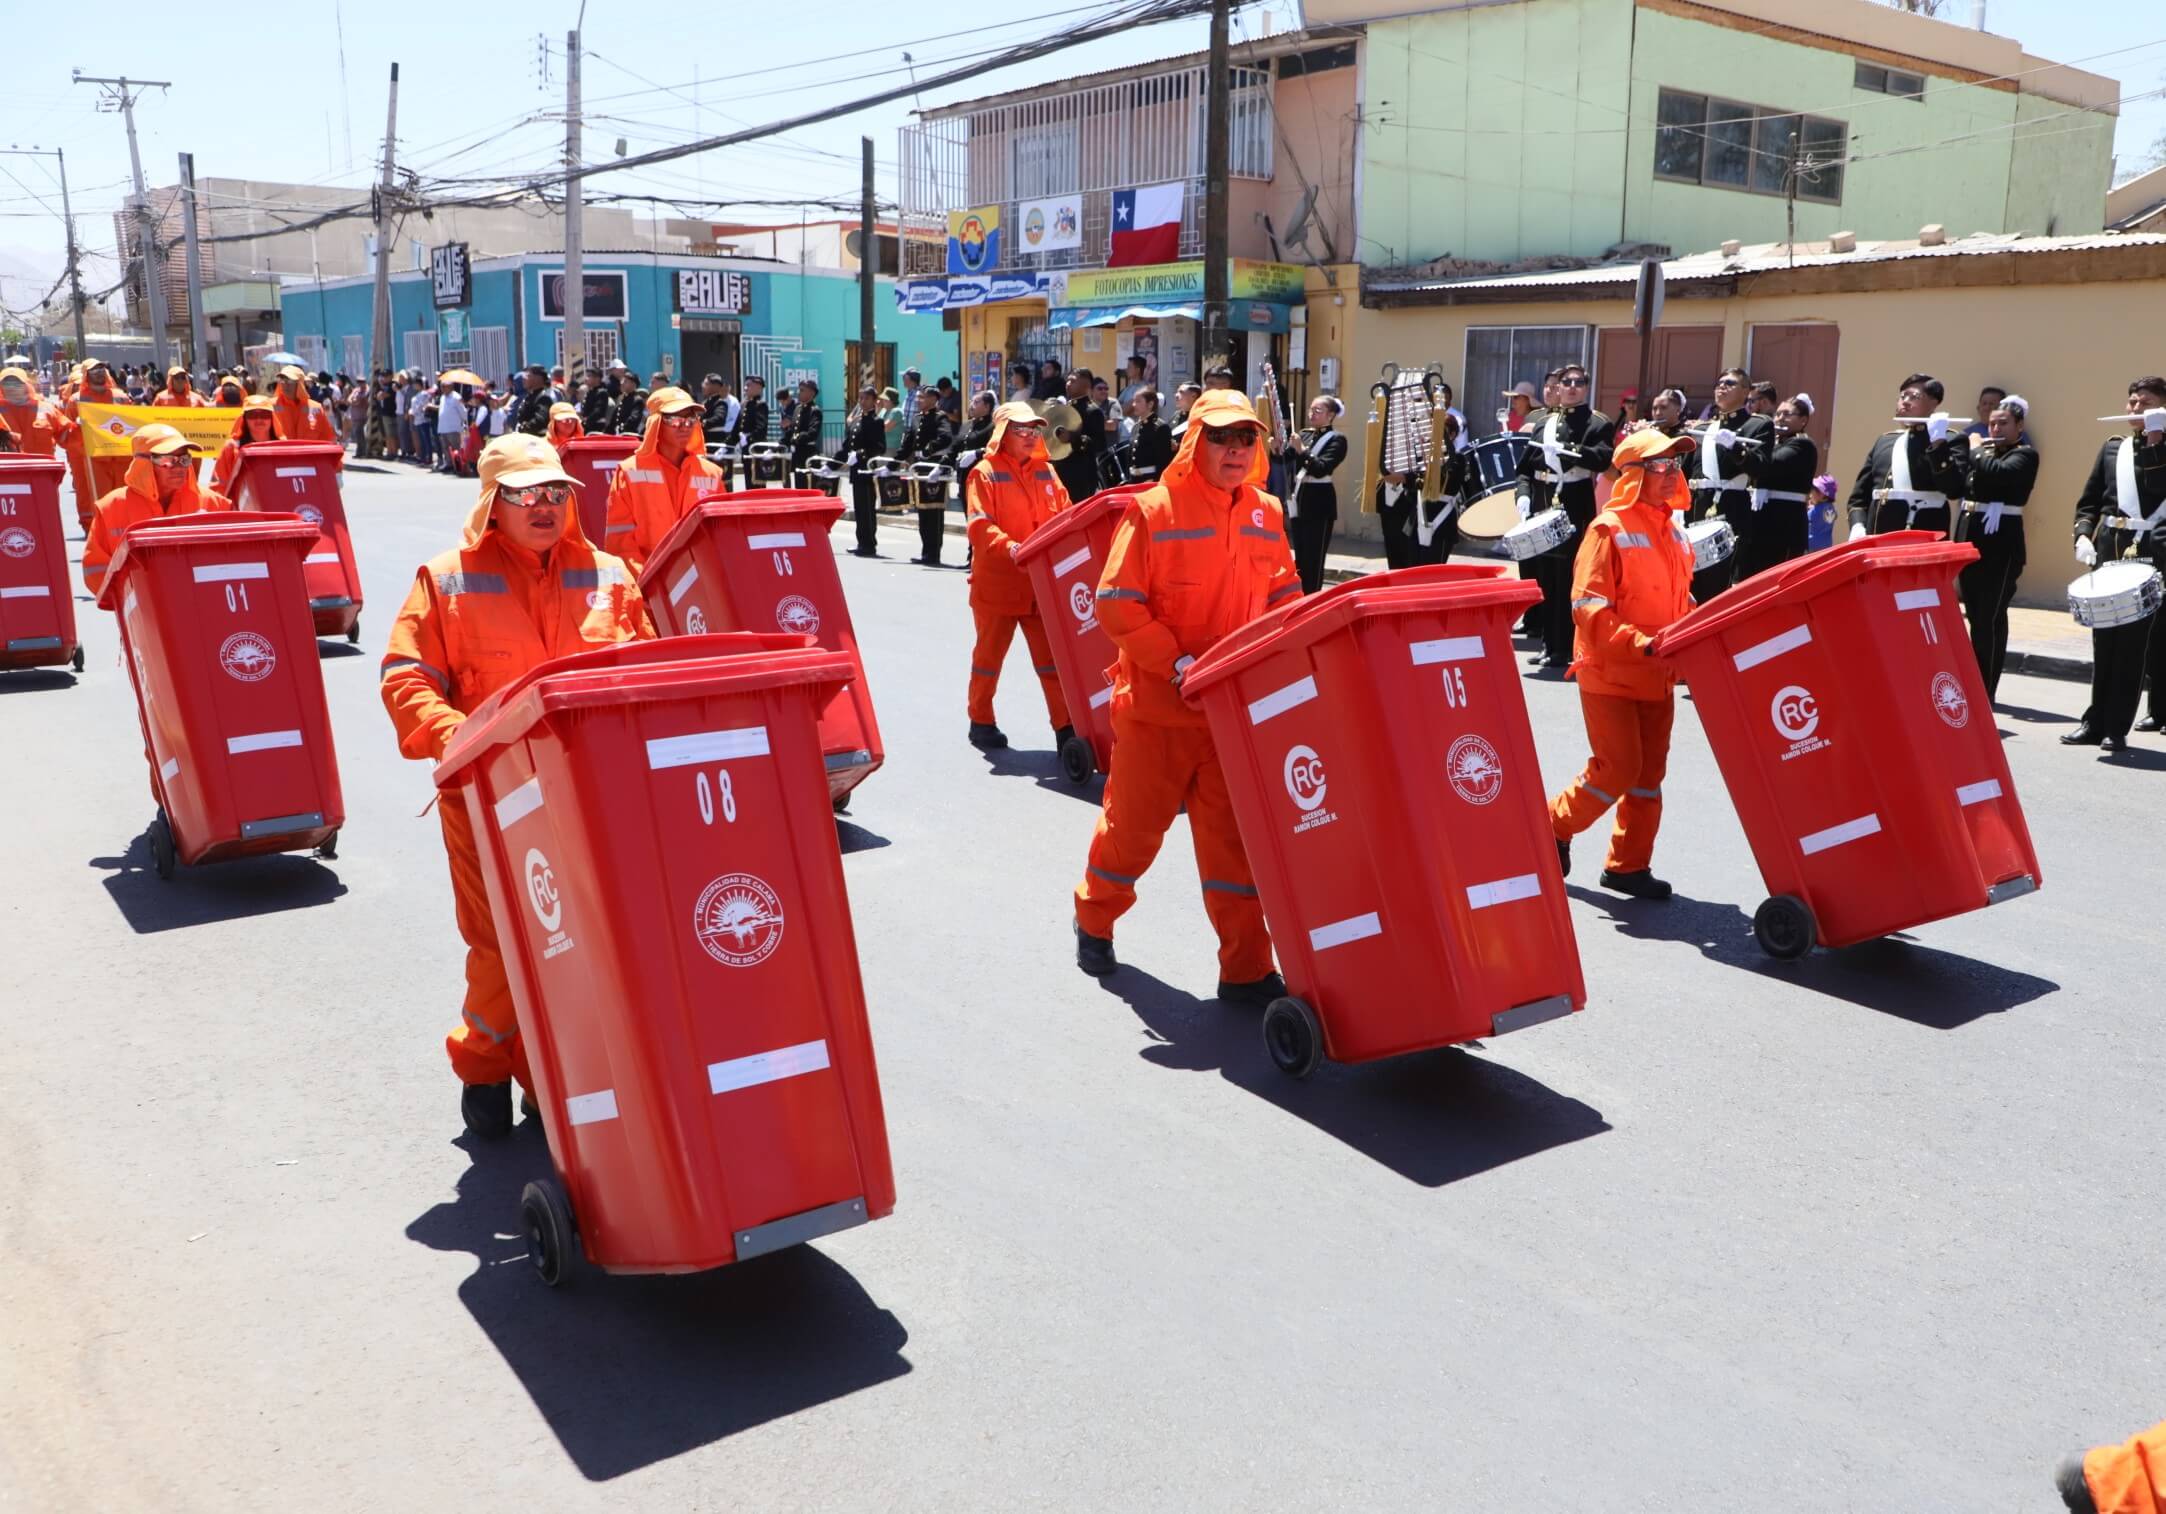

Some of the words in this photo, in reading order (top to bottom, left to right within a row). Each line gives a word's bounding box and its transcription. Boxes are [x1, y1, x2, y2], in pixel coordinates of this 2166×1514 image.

[1094, 276, 1142, 297] FOTOCOPIAS
[1145, 271, 1198, 293] IMPRESIONES
[1, 497, 16, 515] 02
[773, 550, 793, 576] 06
[225, 583, 250, 613] 01
[1442, 666, 1467, 708] 05
[696, 768, 737, 826] 08
[697, 876, 740, 914] MUNICIPALIDAD
[740, 877, 753, 885] DE
[751, 881, 776, 905] CALAMA
[707, 941, 731, 963] TIERRA
[742, 955, 757, 964] SOL
[762, 931, 779, 953] COBRE
